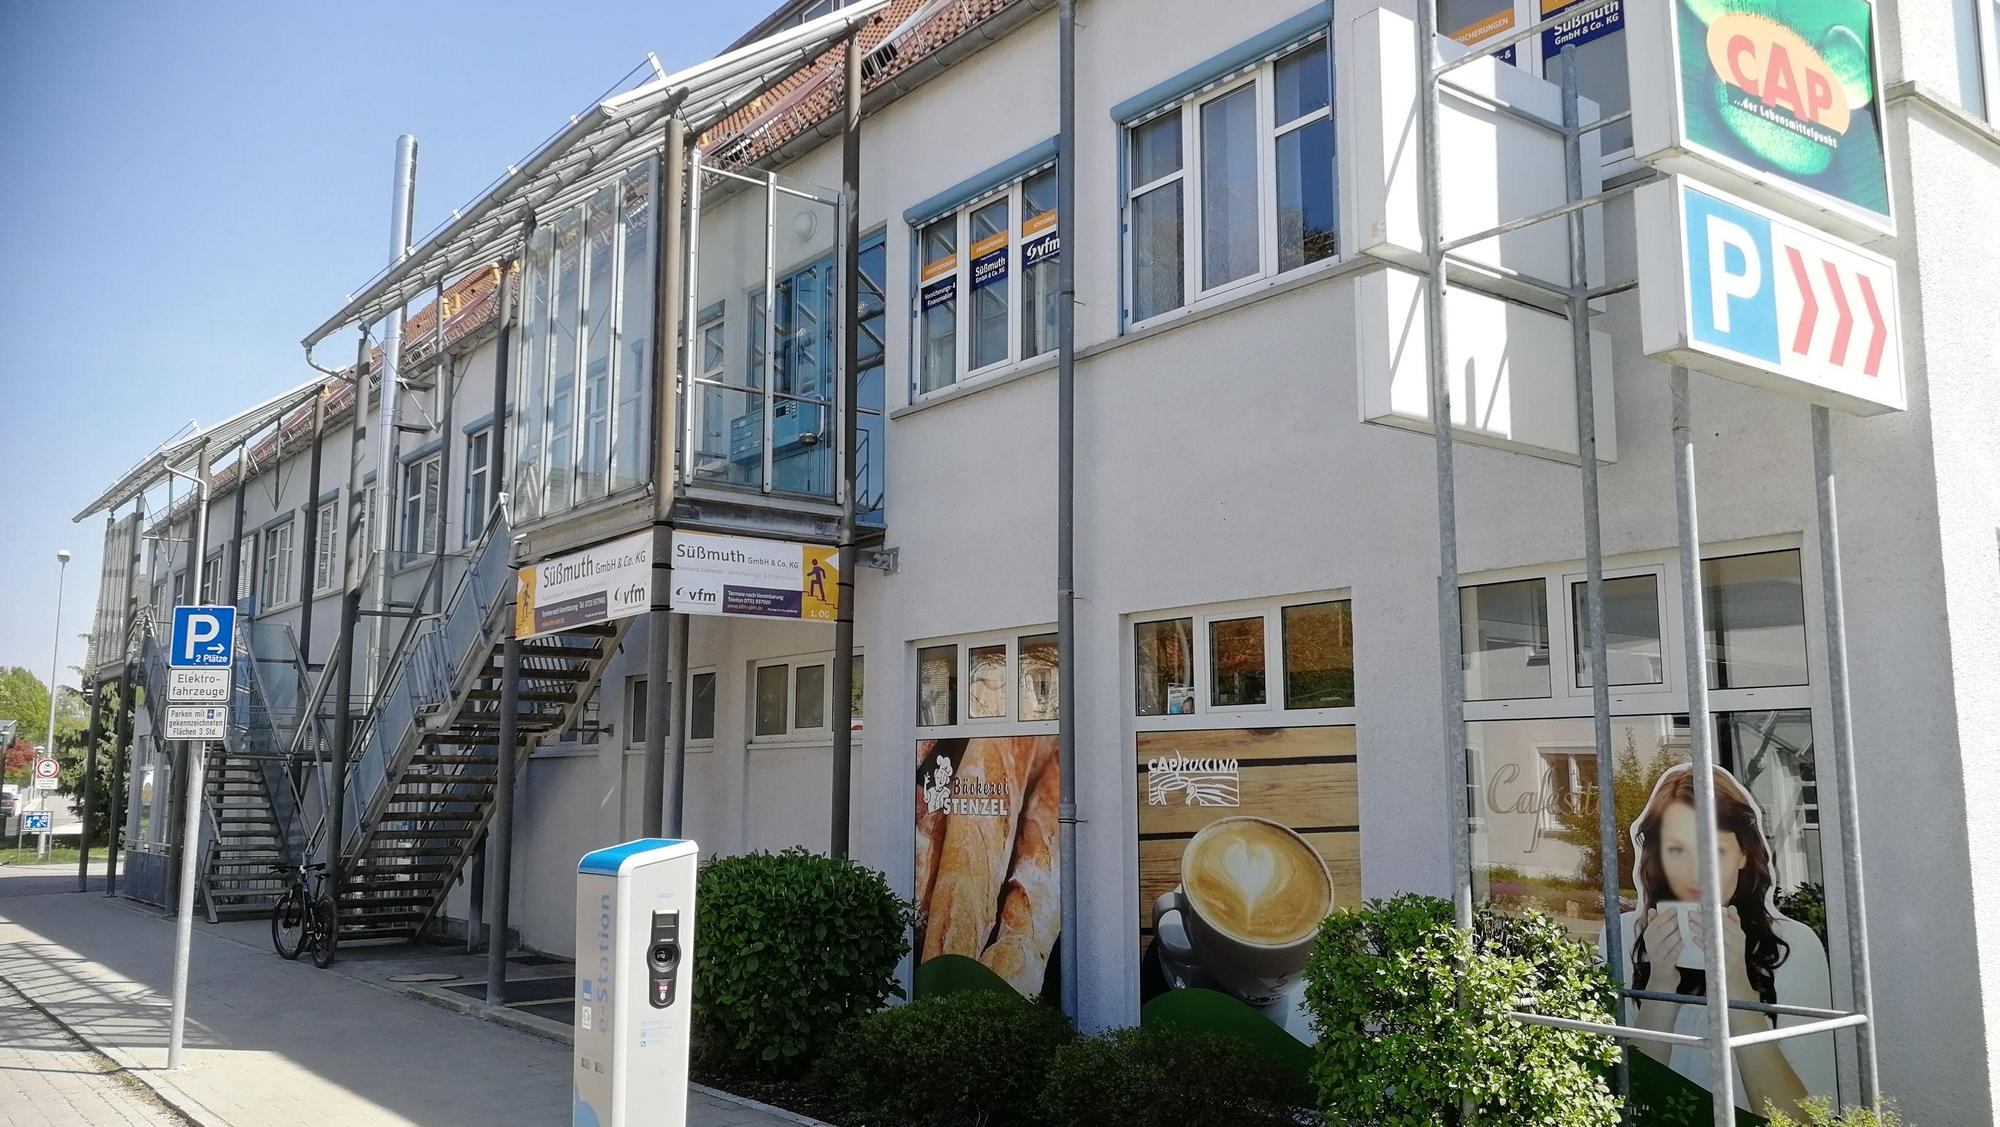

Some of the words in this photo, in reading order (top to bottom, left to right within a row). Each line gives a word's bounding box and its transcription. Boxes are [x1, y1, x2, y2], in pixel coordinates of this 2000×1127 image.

[1456, 17, 1508, 42] SICHERUNGEN
[1554, 28, 1581, 45] GmbH
[1582, 25, 1589, 35] &
[1590, 21, 1604, 31] Co.
[1606, 13, 1619, 25] KG
[1726, 33, 1832, 123] CAP
[1760, 105, 1838, 149] Lebensmittelpunkt
[1037, 236, 1060, 256] vfm
[975, 256, 1006, 277] Süßmuth
[1706, 213, 1762, 334] P
[676, 544, 745, 563] Süßmuth
[748, 557, 770, 566] GmbH
[771, 559, 776, 567] &
[777, 560, 788, 568] Co.
[789, 561, 799, 569] KG
[543, 554, 594, 589] Süßmuth
[595, 558, 617, 574] GmbH
[617, 557, 622, 569] &
[624, 555, 634, 568] Co.
[635, 550, 646, 564] KG
[624, 583, 645, 605] vfm
[688, 588, 716, 602] vfm
[818, 610, 830, 618] OG
[185, 614, 220, 660] P
[195, 654, 202, 663] 2
[203, 654, 228, 663] Plätze
[177, 673, 221, 684] Elektro-
[172, 686, 225, 698] fahrzeuge
[171, 709, 192, 718] Parken
[194, 709, 206, 718] mit
[168, 719, 223, 729] gekennzeichneten
[172, 727, 197, 736] Flächen
[199, 727, 203, 736] 3
[1147, 756, 1239, 772] CAPPUCCINO
[953, 776, 1009, 796] Bäckerei
[943, 798, 1008, 816] STENZEL
[597, 894, 611, 1034] e-Station
